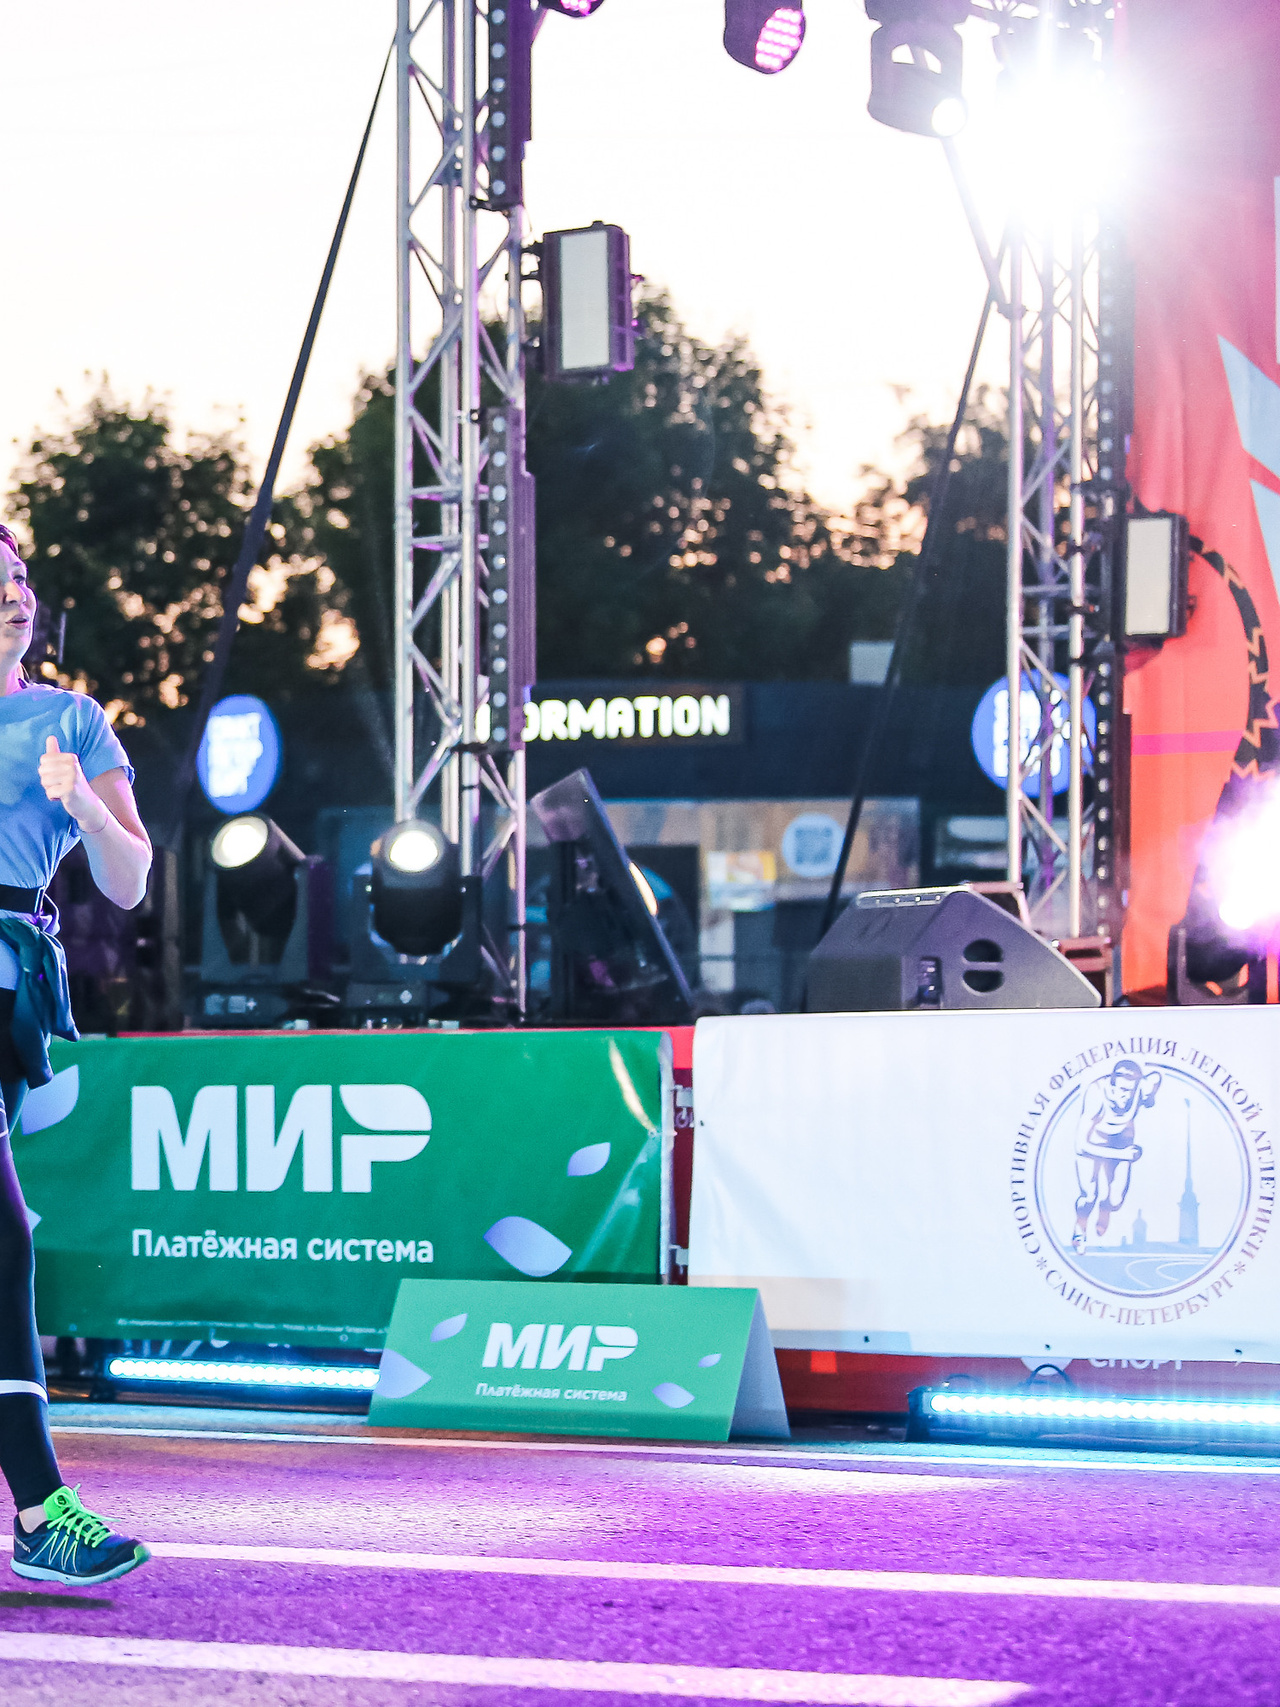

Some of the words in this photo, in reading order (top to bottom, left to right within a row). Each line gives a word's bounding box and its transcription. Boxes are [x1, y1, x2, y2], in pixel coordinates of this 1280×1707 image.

[131, 1083, 433, 1193] МИР
[1010, 1092, 1051, 1255] СПОРТИВНАЯ
[1049, 1036, 1177, 1090] ФЕДЕРАЦИЯ
[1180, 1047, 1263, 1122] ЛЕГКОЙ
[1240, 1129, 1276, 1260] АТЛЕТИКИ
[131, 1229, 298, 1260] Платёжная
[306, 1237, 434, 1264] система
[1044, 1268, 1235, 1326] САНКТ-ПЕТЕРБУРГ
[482, 1322, 639, 1372] МИР
[475, 1383, 561, 1399] Платёжная
[564, 1388, 628, 1401] система
